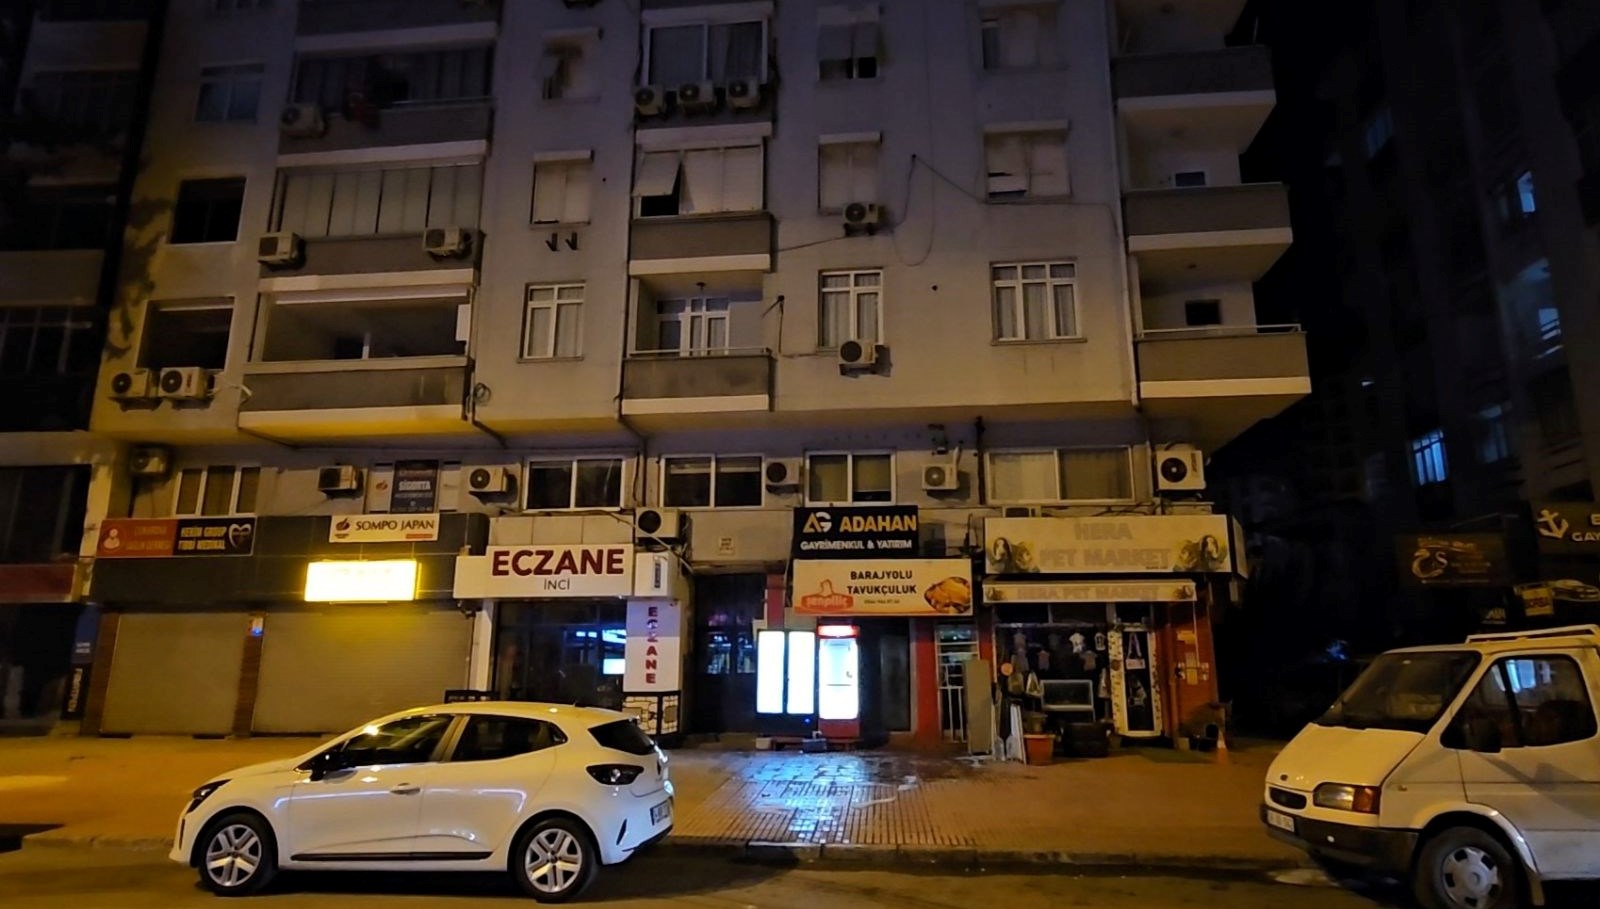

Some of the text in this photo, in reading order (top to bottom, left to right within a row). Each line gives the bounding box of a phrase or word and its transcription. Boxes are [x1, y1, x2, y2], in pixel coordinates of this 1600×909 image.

[355, 519, 434, 531] SOMPO JAPAN
[839, 514, 917, 533] ADAHAN
[1074, 522, 1134, 541] HERA
[800, 538, 865, 551] GAYRİMENKUL
[867, 539, 875, 550] &
[492, 548, 625, 577] ECZANE
[1039, 548, 1170, 567] PET MARKET
[850, 570, 913, 580] BARAJYOLU
[543, 577, 571, 591] İNCİ
[847, 584, 917, 596] TAVUKÇULUK
